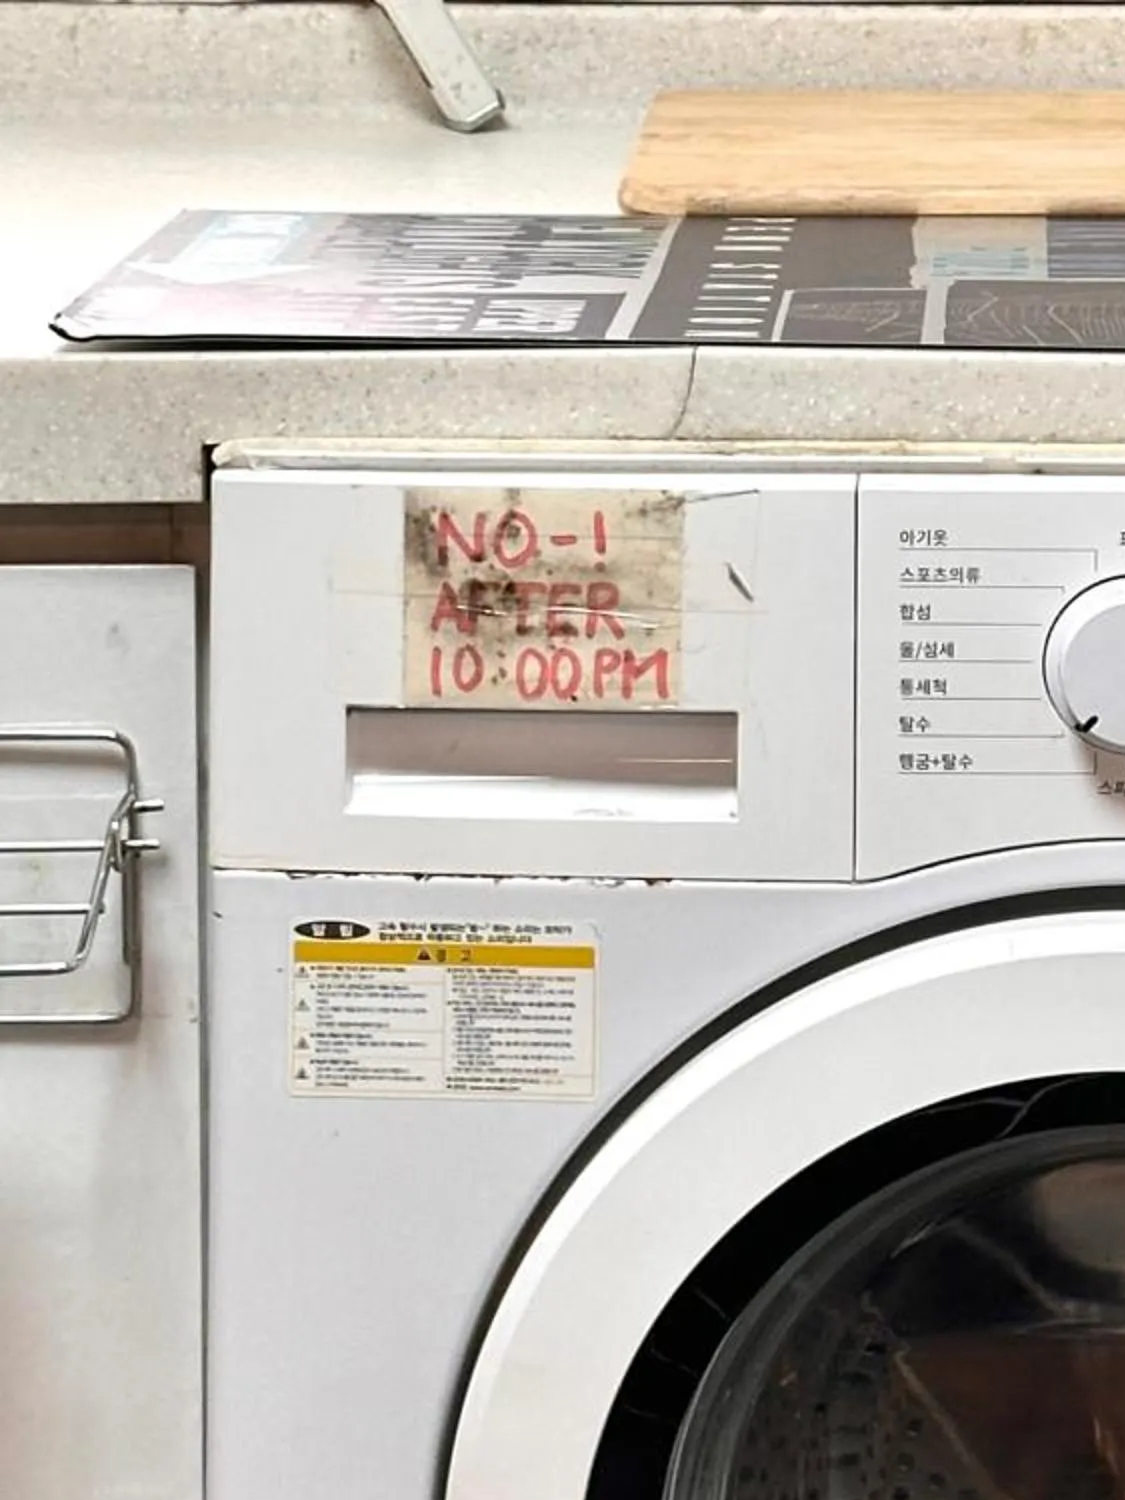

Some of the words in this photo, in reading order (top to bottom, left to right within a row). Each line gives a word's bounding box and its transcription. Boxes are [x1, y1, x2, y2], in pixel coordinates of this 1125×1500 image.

[899, 529, 948, 547] 아기옷
[899, 567, 981, 583] 스포츠의류
[430, 580, 625, 640] AFTER
[899, 604, 932, 621] 합성
[899, 641, 955, 659] 울/섬세
[899, 678, 948, 695] 통세척
[899, 716, 931, 733] 탈수
[899, 753, 973, 771] 헹굼+탈수
